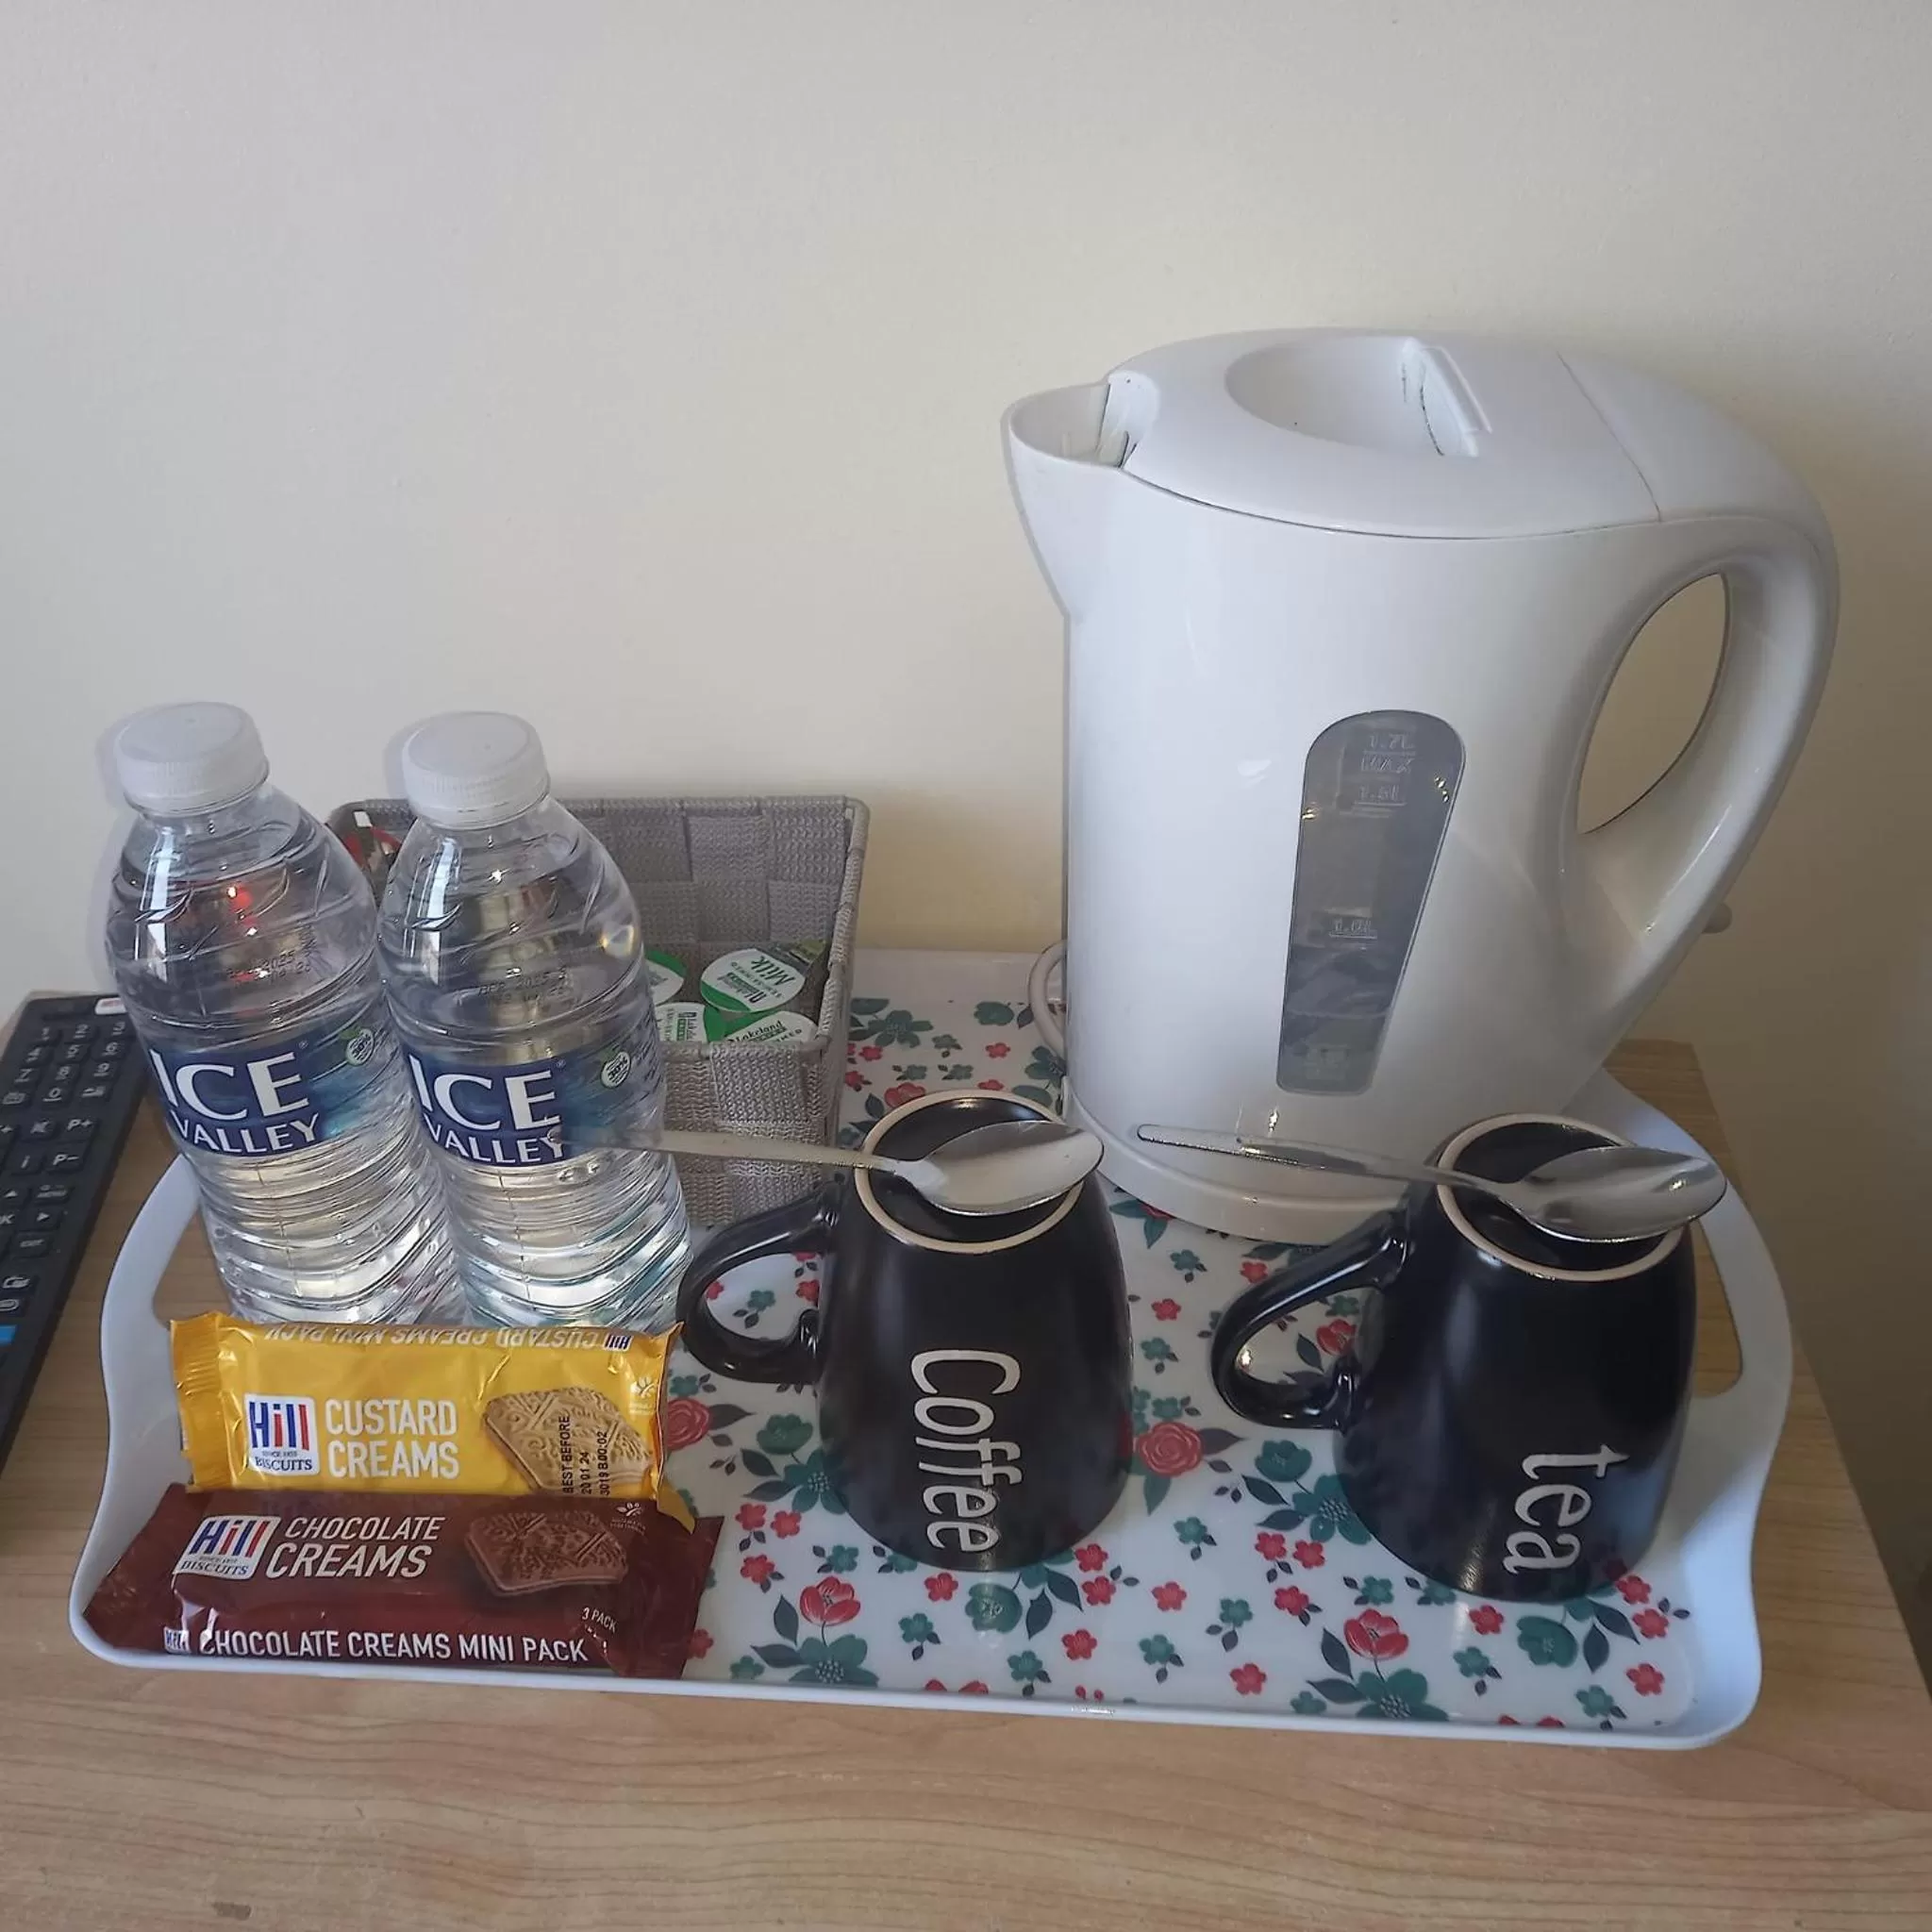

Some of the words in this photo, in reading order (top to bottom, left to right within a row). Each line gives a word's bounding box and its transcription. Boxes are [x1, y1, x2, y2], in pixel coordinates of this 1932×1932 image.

[752, 956, 795, 986] Milk
[149, 1048, 309, 1121] ICE
[408, 1054, 560, 1131] ICE
[170, 1112, 319, 1153] VALLEY
[424, 1112, 565, 1163] VALLEY
[496, 1327, 597, 1350] CUSTARD
[249, 1401, 309, 1452] Hill
[325, 1399, 458, 1436] CUSTARD
[558, 1414, 573, 1462] BEFORE
[910, 1349, 1022, 1552] Coffee
[255, 1456, 313, 1471] BISCUITS
[327, 1440, 460, 1479] CREAMS
[561, 1464, 574, 1493] BEST
[1503, 1443, 1630, 1574] tea
[189, 1519, 271, 1558] Hill
[285, 1516, 445, 1540] CHOCOLATE
[181, 1560, 249, 1575] BISCUITS
[266, 1541, 432, 1578] CREAMS
[582, 1607, 590, 1621] 3
[591, 1608, 617, 1633] PACK
[200, 1629, 341, 1657] CHOCOLATE
[348, 1631, 451, 1659] CREAMS
[458, 1634, 514, 1661] MINI
[521, 1637, 589, 1662] PACK
